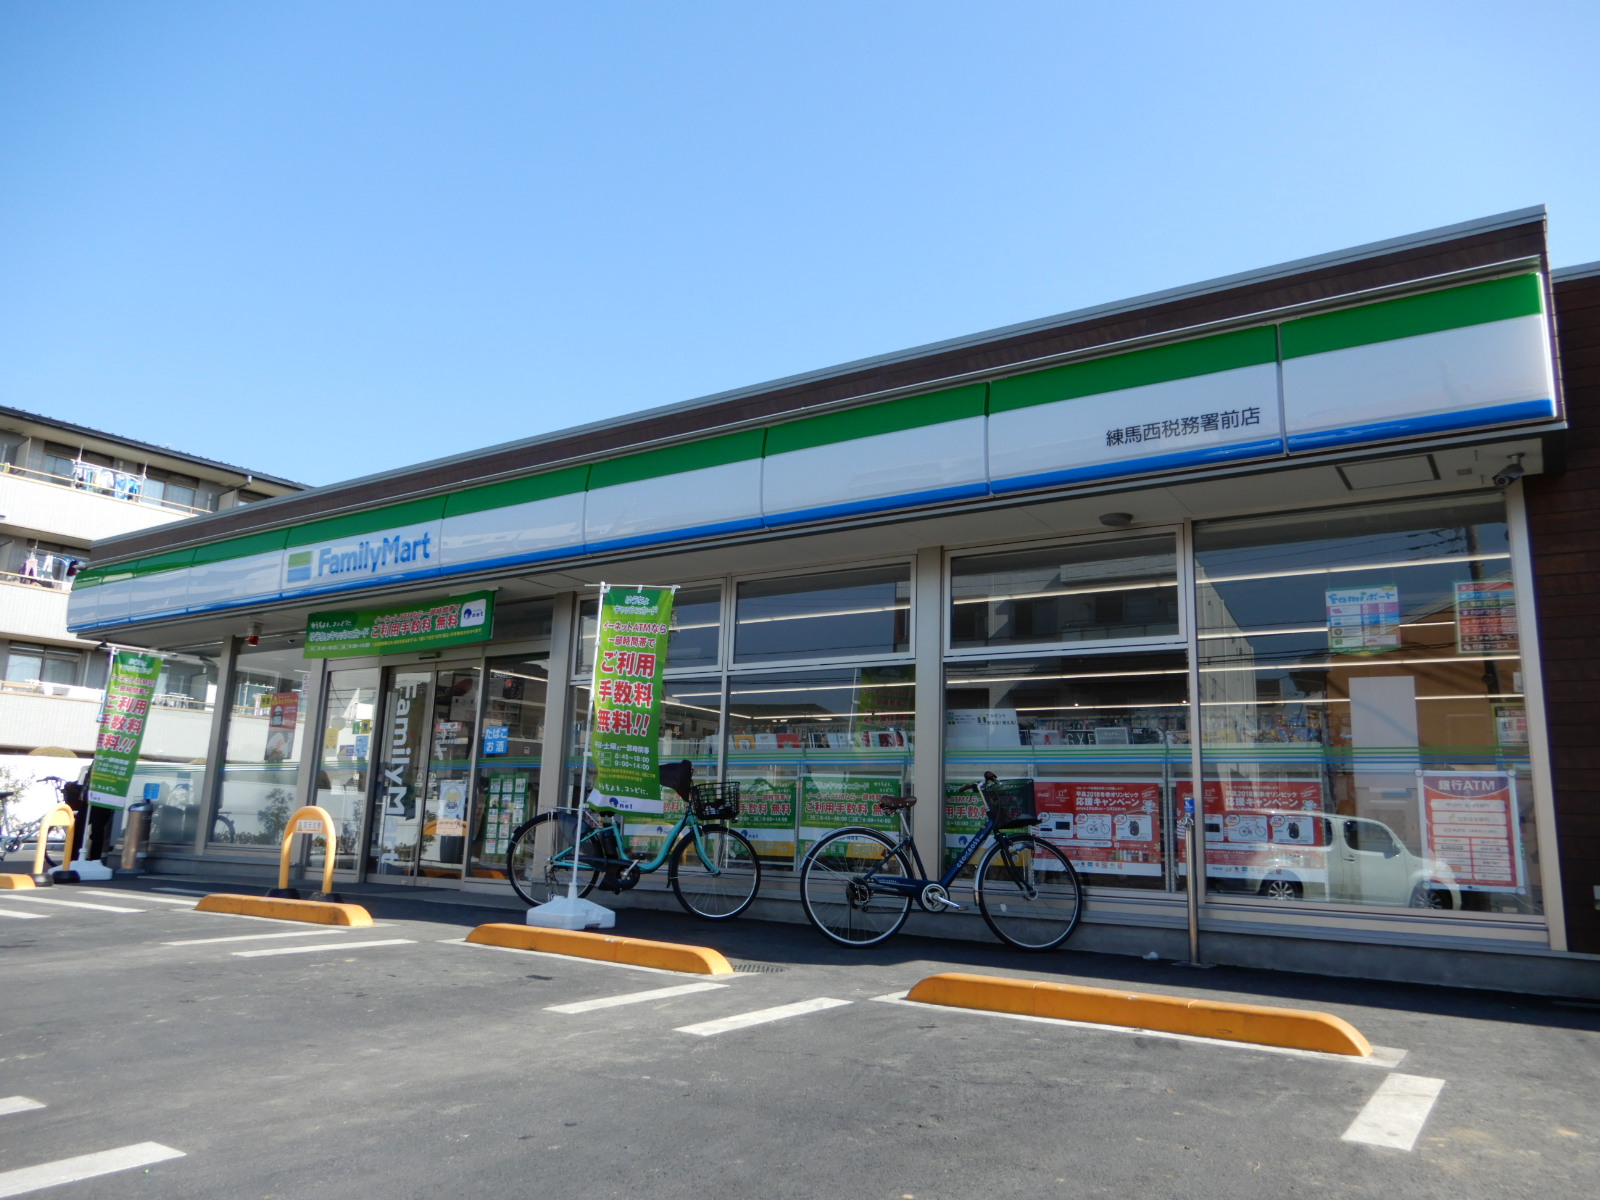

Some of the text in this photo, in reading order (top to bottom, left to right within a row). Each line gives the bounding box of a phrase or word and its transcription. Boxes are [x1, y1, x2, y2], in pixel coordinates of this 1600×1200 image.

[1106, 406, 1261, 448] 練馬西税務署前店
[318, 531, 431, 577] FamilyMart
[371, 618, 432, 638] ご利用手数料
[435, 613, 459, 631] 無料
[603, 620, 667, 634] イーネットATMなら
[608, 635, 656, 648] 一部時間帯で
[600, 650, 656, 678] ご利用
[598, 679, 654, 708] 手数料
[105, 694, 149, 716] ご利用
[596, 708, 650, 737] 無料!!
[485, 727, 508, 740] たばこ
[485, 740, 505, 753] お酒
[1438, 779, 1496, 792] 銀行ATM
[805, 801, 896, 817] ご利用手数料 無
[1076, 797, 1140, 807] 応援キャンペーン
[1225, 797, 1299, 808] 応援キャンペーン
[771, 803, 792, 817] 無料
